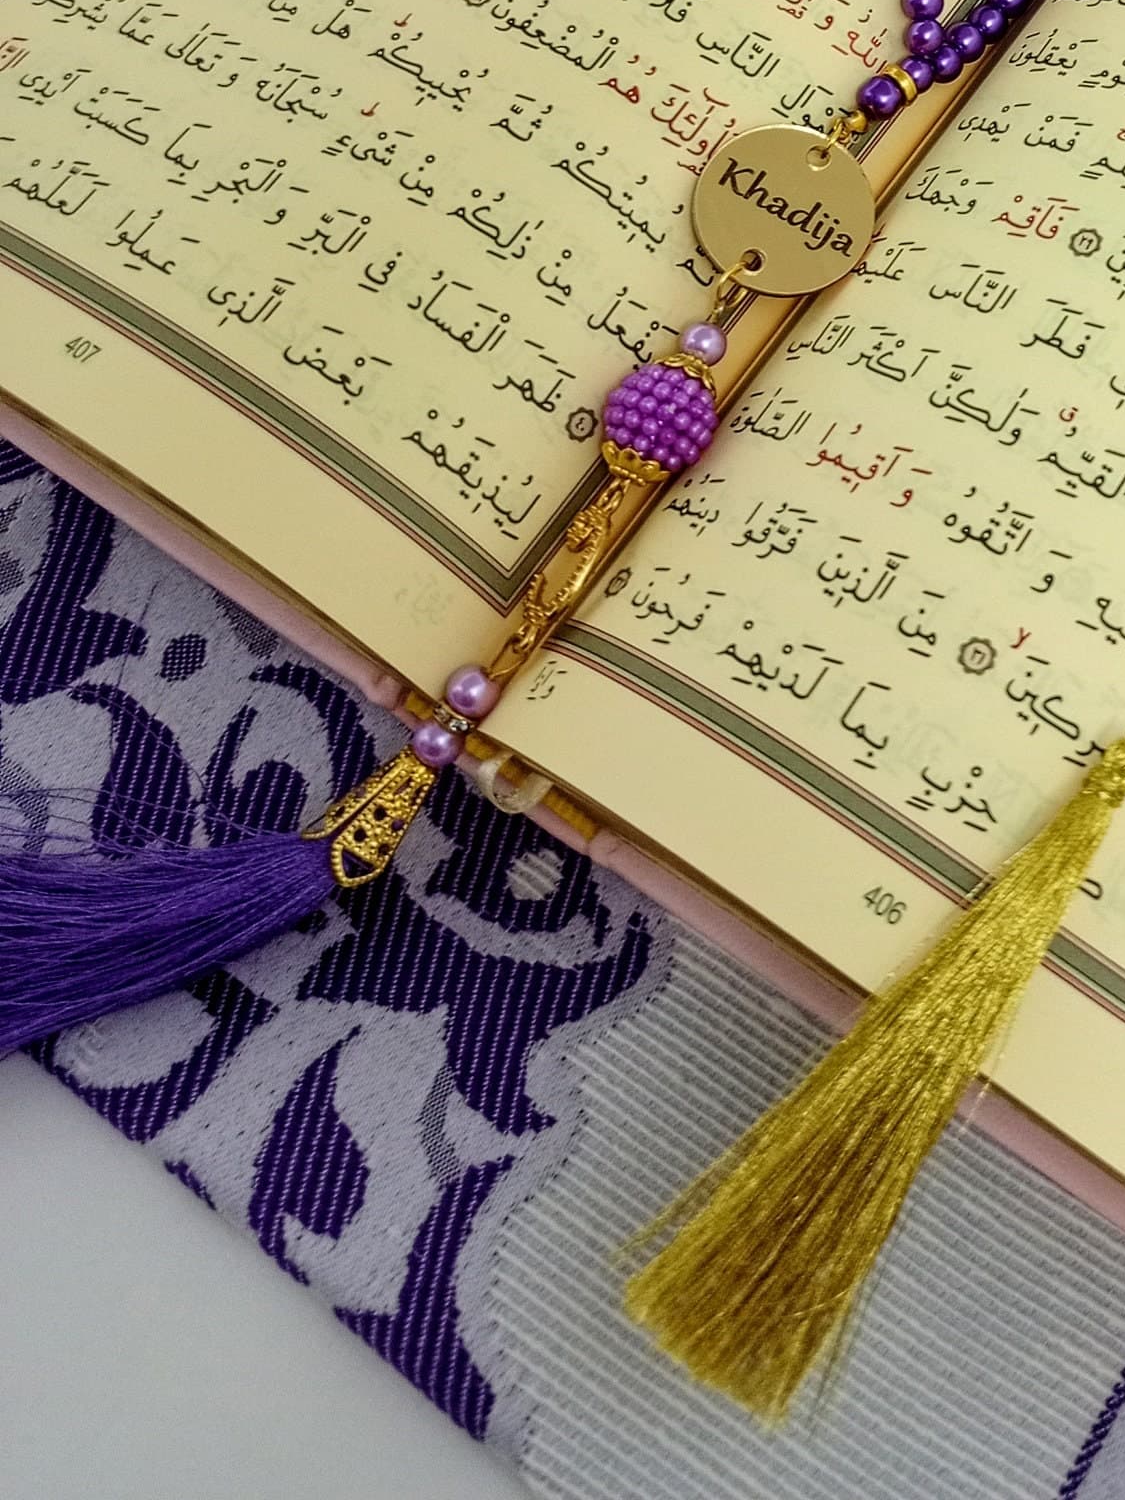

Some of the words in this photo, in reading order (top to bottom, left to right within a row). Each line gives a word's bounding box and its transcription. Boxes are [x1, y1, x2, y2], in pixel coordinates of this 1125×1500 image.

[718, 157, 853, 258] Khadija
[64, 336, 101, 363] 407
[863, 886, 907, 925] 406
